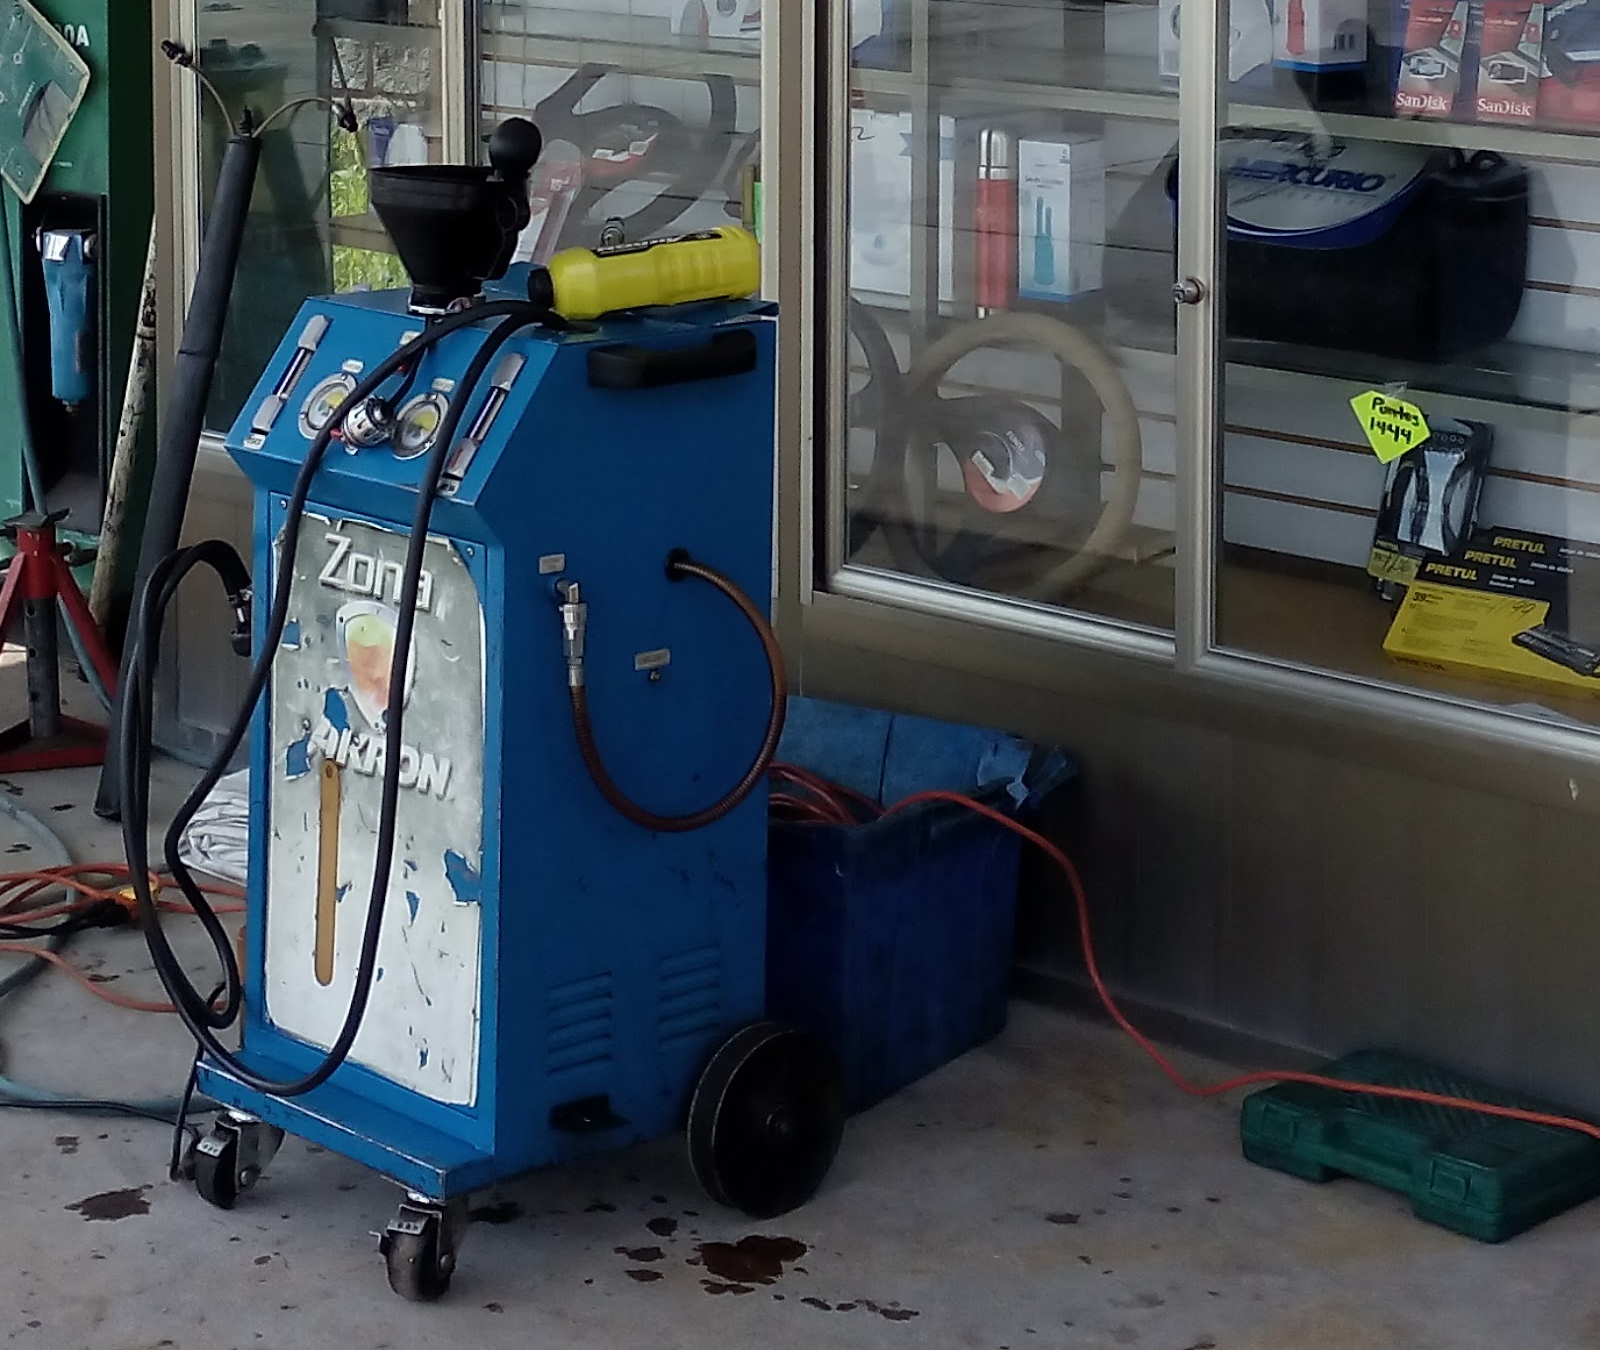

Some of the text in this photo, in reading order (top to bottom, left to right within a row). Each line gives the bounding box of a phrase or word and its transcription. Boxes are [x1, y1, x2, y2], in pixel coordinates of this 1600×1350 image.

[1395, 91, 1448, 111] SanDisk
[1477, 99, 1532, 117] SanDisk
[1493, 536, 1545, 555] PRETUL
[1464, 550, 1516, 569] PRETUL
[318, 531, 433, 612] Zona
[1425, 562, 1478, 581] PRETUL
[308, 721, 451, 798] AKRON
